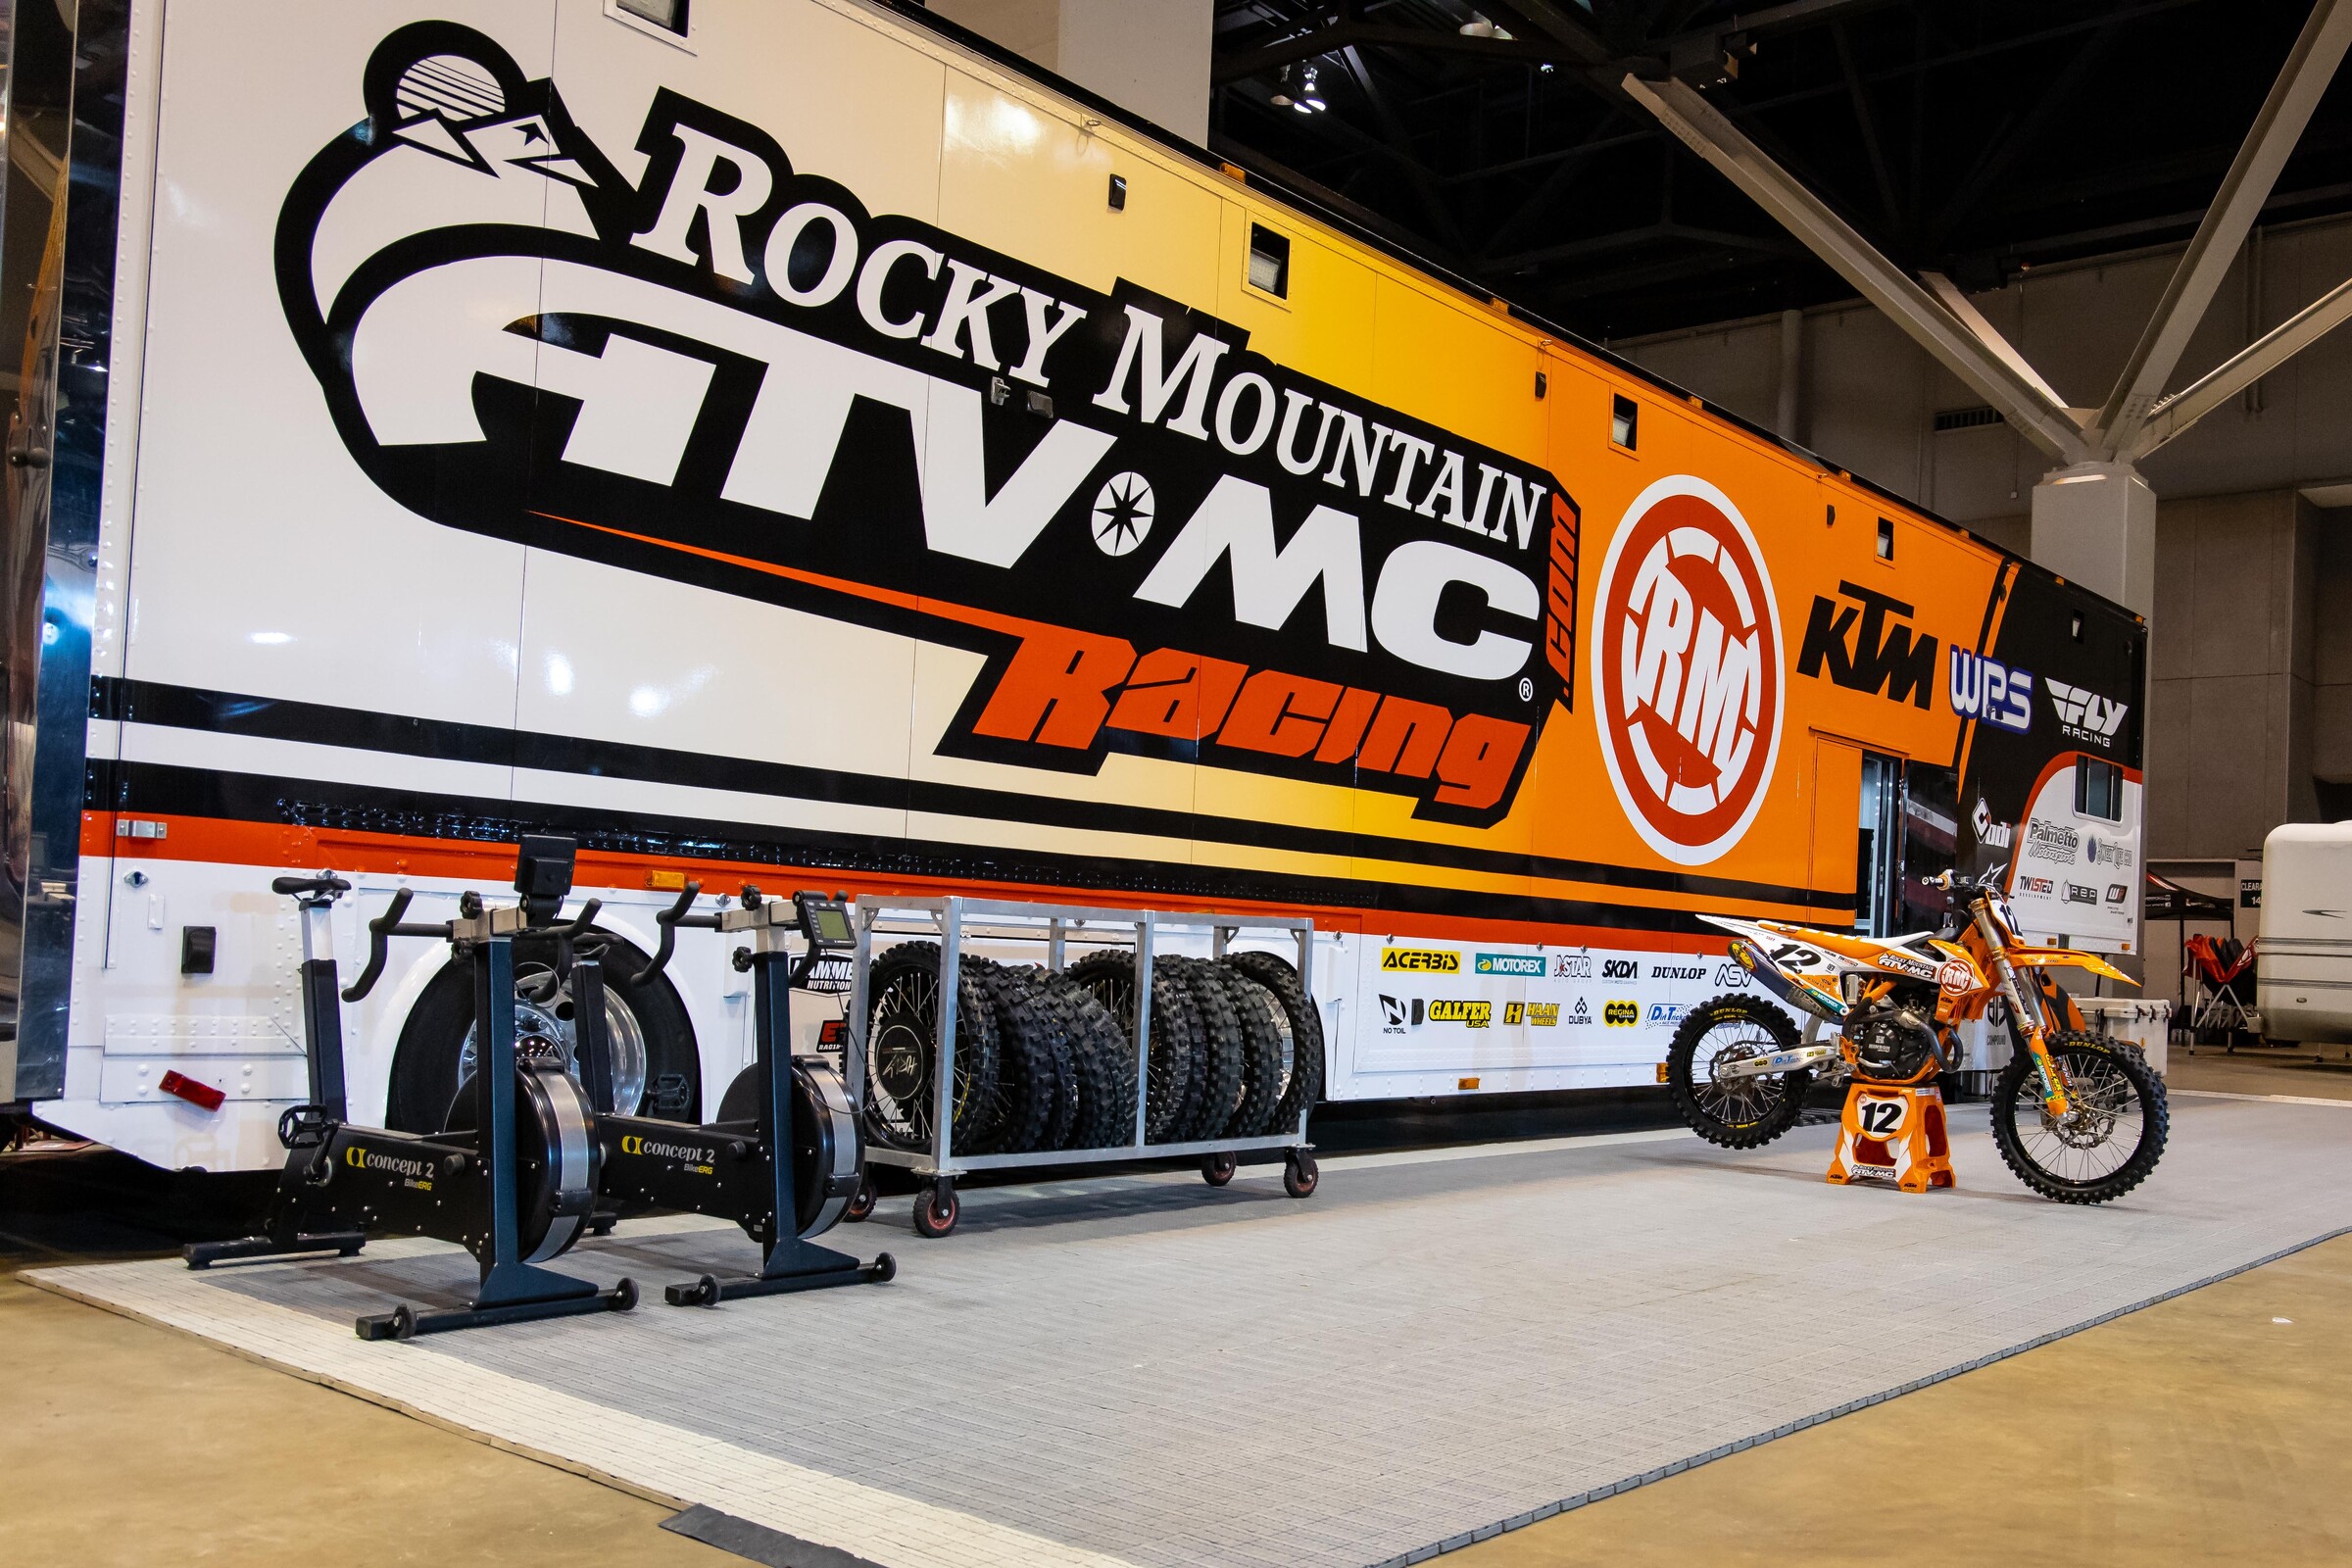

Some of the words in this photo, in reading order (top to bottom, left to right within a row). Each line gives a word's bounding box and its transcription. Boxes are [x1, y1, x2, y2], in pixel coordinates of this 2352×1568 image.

[630, 122, 1086, 387] ROCKY
[1092, 305, 1546, 549] MOUNTAIN
[1796, 580, 1937, 710] KTM
[1951, 649, 2033, 730] WPS
[970, 623, 1531, 809] Racing
[2045, 677, 2129, 735] FLY
[2062, 725, 2110, 748] RACING
[2029, 820, 2079, 850] Palmetto
[2241, 882, 2262, 891] CLEARA
[1493, 957, 1541, 973] MOTOREX
[1602, 959, 1638, 979] SKDA
[1770, 944, 1821, 973] 12
[1651, 966, 1706, 979] DUNLOP
[1429, 1001, 1491, 1020] GALFER
[1527, 1003, 1560, 1016] HAAN
[1569, 1015, 1592, 1024] DUBYA
[1531, 1017, 1557, 1026] WHEELS
[2069, 1041, 2110, 1054] DUNLOP
[1862, 1102, 1902, 1133] 12
[643, 1141, 703, 1161] concept
[706, 1149, 715, 1163] 2
[367, 1152, 422, 1176] concept
[425, 1162, 435, 1178] 2
